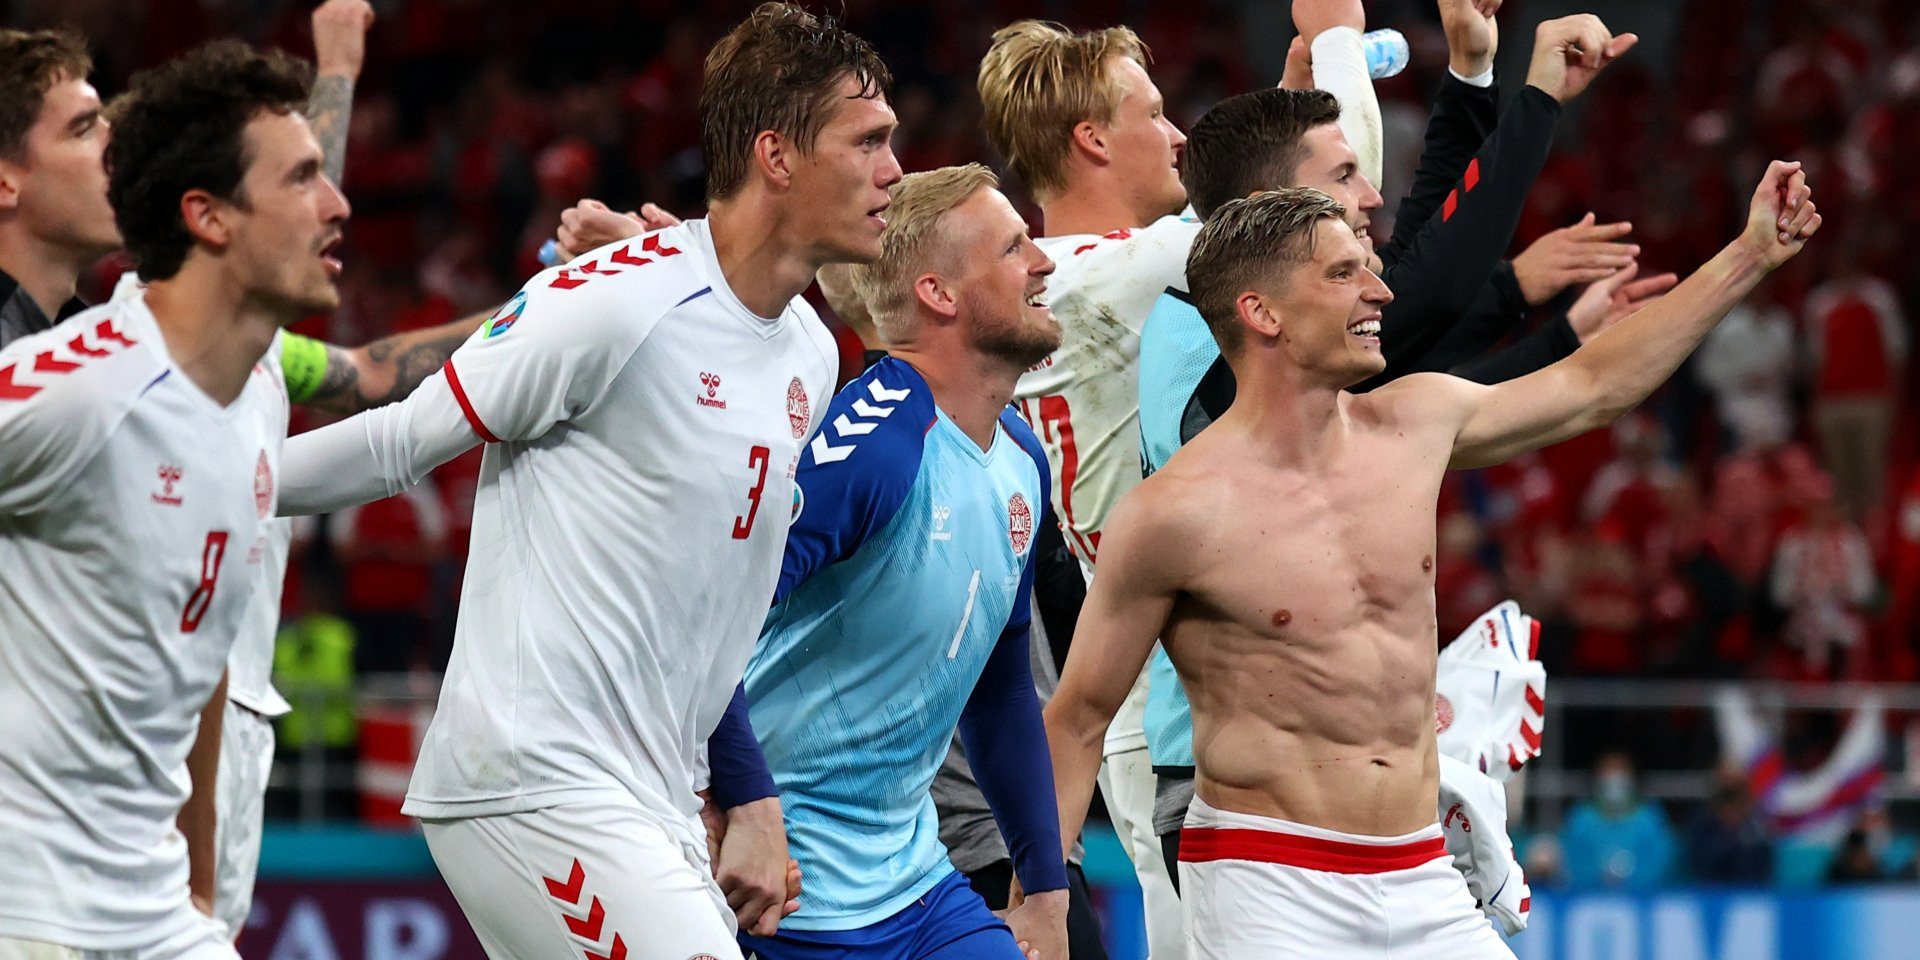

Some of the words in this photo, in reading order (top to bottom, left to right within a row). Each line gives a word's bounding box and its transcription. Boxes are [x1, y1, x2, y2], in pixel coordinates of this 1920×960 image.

[697, 394, 727, 410] hummel
[731, 445, 770, 540] 3
[1010, 514, 1026, 532] DBU
[180, 531, 229, 634] 8
[946, 569, 981, 659] 1
